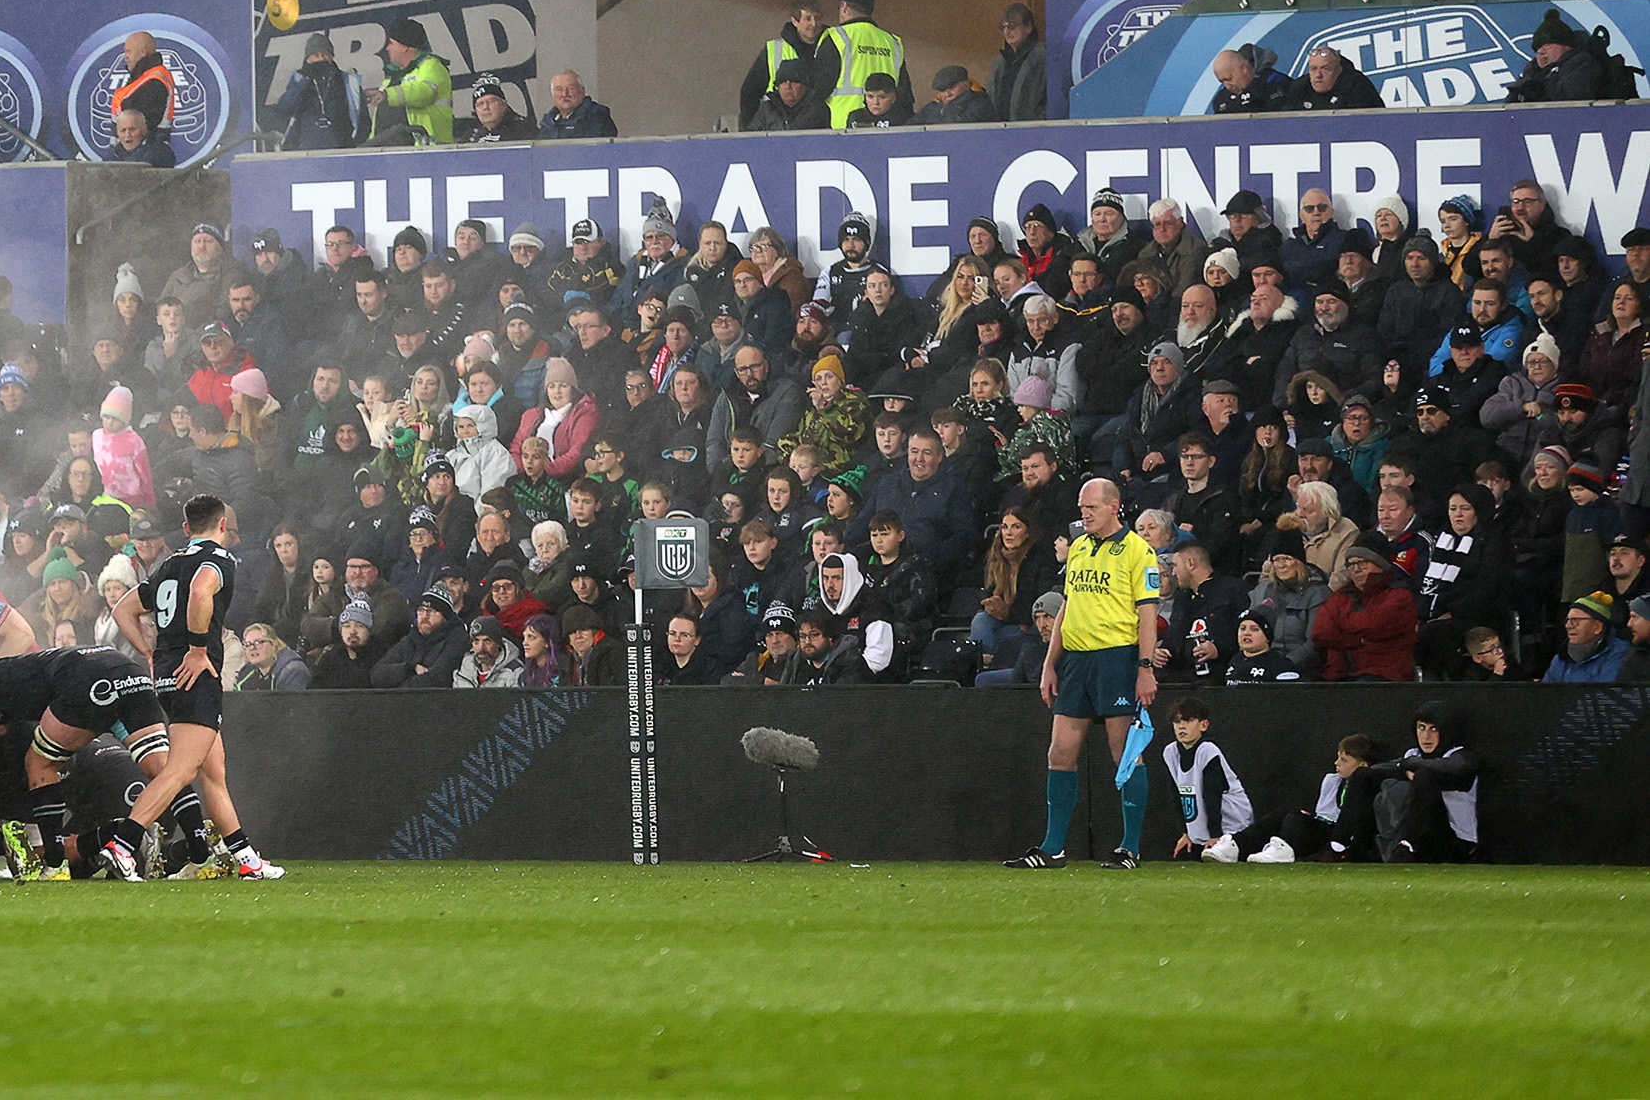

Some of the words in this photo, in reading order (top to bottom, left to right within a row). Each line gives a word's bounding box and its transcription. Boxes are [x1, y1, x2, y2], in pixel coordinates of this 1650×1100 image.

[1328, 17, 1467, 70] THE
[291, 174, 506, 266] THE
[544, 156, 950, 278] TRADE
[664, 529, 687, 538] BKT
[156, 579, 178, 629] 9
[1067, 569, 1111, 587] QATAR
[1073, 584, 1110, 595] AIRWAYS
[627, 646, 640, 737] UNITEDRUGBY.COM
[643, 645, 655, 737] UNITEDRUGBY.COM
[630, 757, 643, 848] UNITEDRUGBY.COM
[647, 757, 658, 848] UNITEDRUGBY.COM
